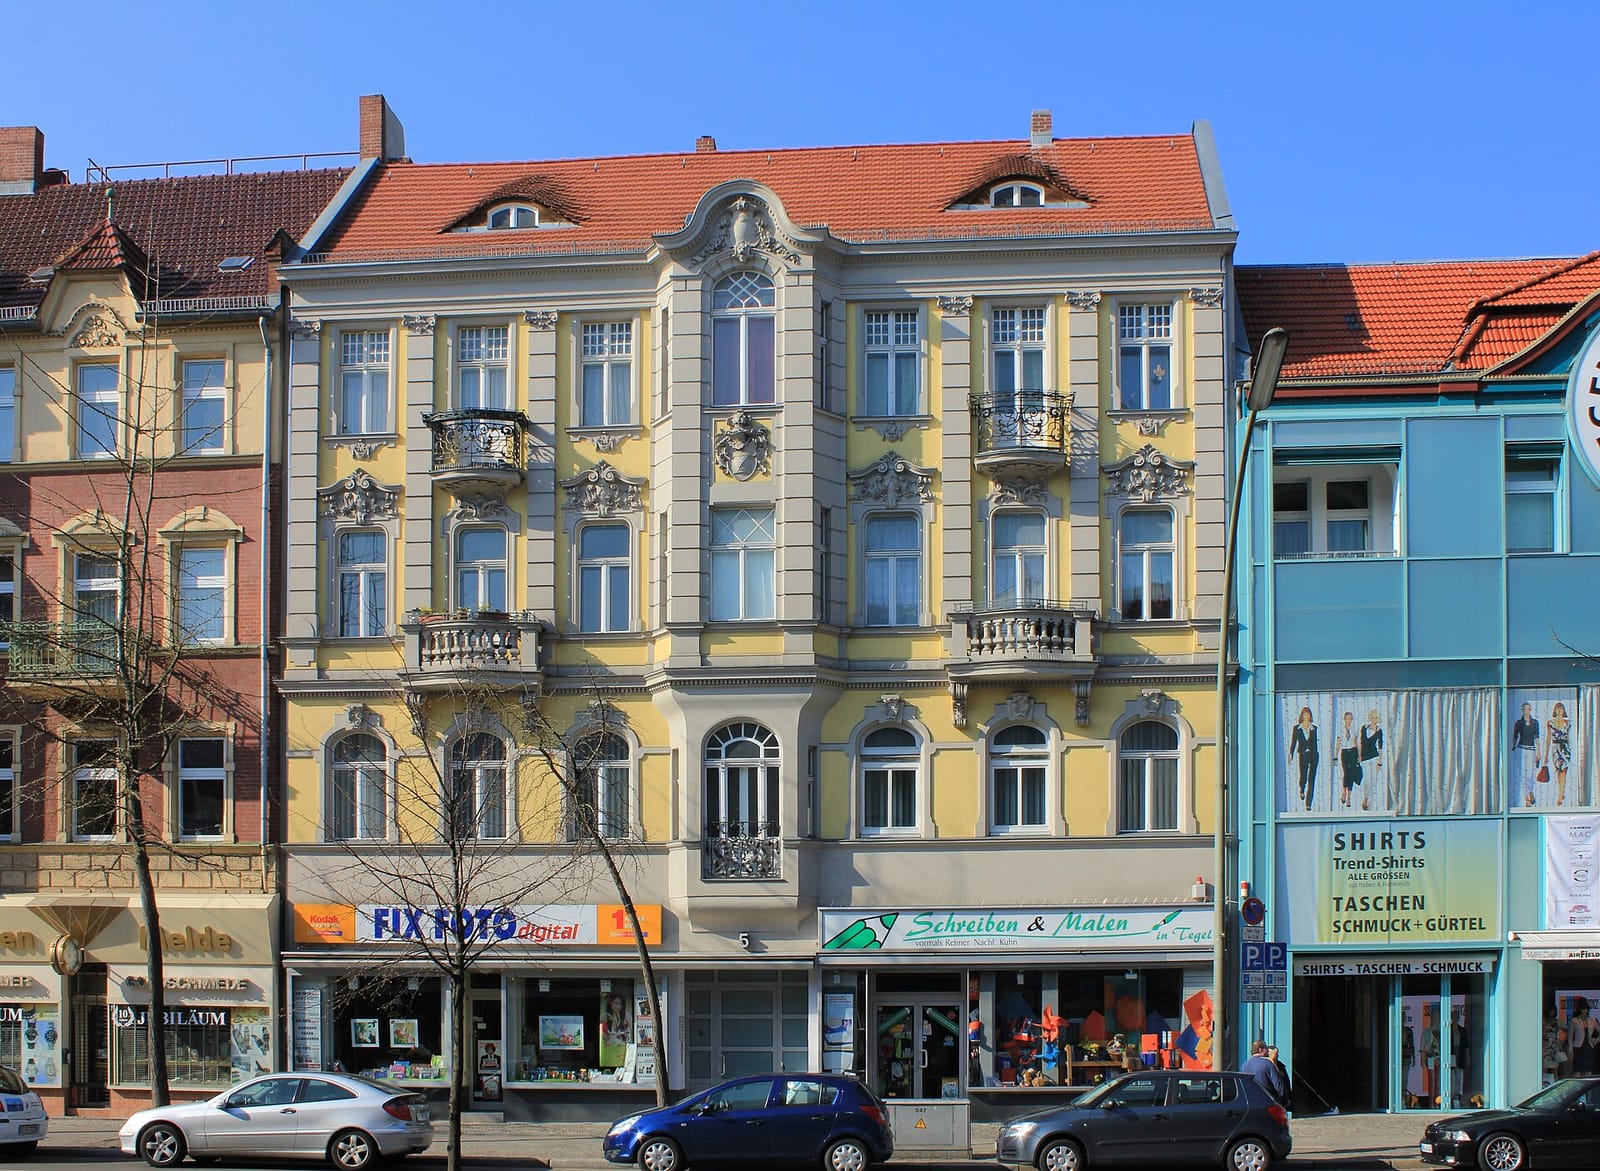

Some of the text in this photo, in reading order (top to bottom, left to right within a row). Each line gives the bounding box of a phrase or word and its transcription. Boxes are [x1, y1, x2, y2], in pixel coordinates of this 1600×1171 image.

[1333, 831, 1426, 851] SHIRTS
[1332, 856, 1425, 870] Trend-Shirts
[1347, 873, 1369, 881] ALLE
[1332, 895, 1425, 912] TASCHEN
[310, 915, 339, 923] Kodak
[374, 908, 425, 939] FIX
[611, 909, 624, 929] 1
[905, 911, 1129, 937] Schreiben & Malen
[518, 923, 579, 943] digital
[738, 932, 750, 949] 5
[1156, 926, 1213, 944] in Tegel
[915, 938, 943, 947] vormals
[1247, 946, 1259, 967] P
[1270, 946, 1281, 967] P
[1303, 963, 1345, 975] SHIRTS
[1356, 962, 1411, 974] TASCHEN
[1423, 961, 1483, 973] SCHMUCK
[119, 1009, 128, 1019] 10
[137, 1009, 226, 1026] JBILÄUM
